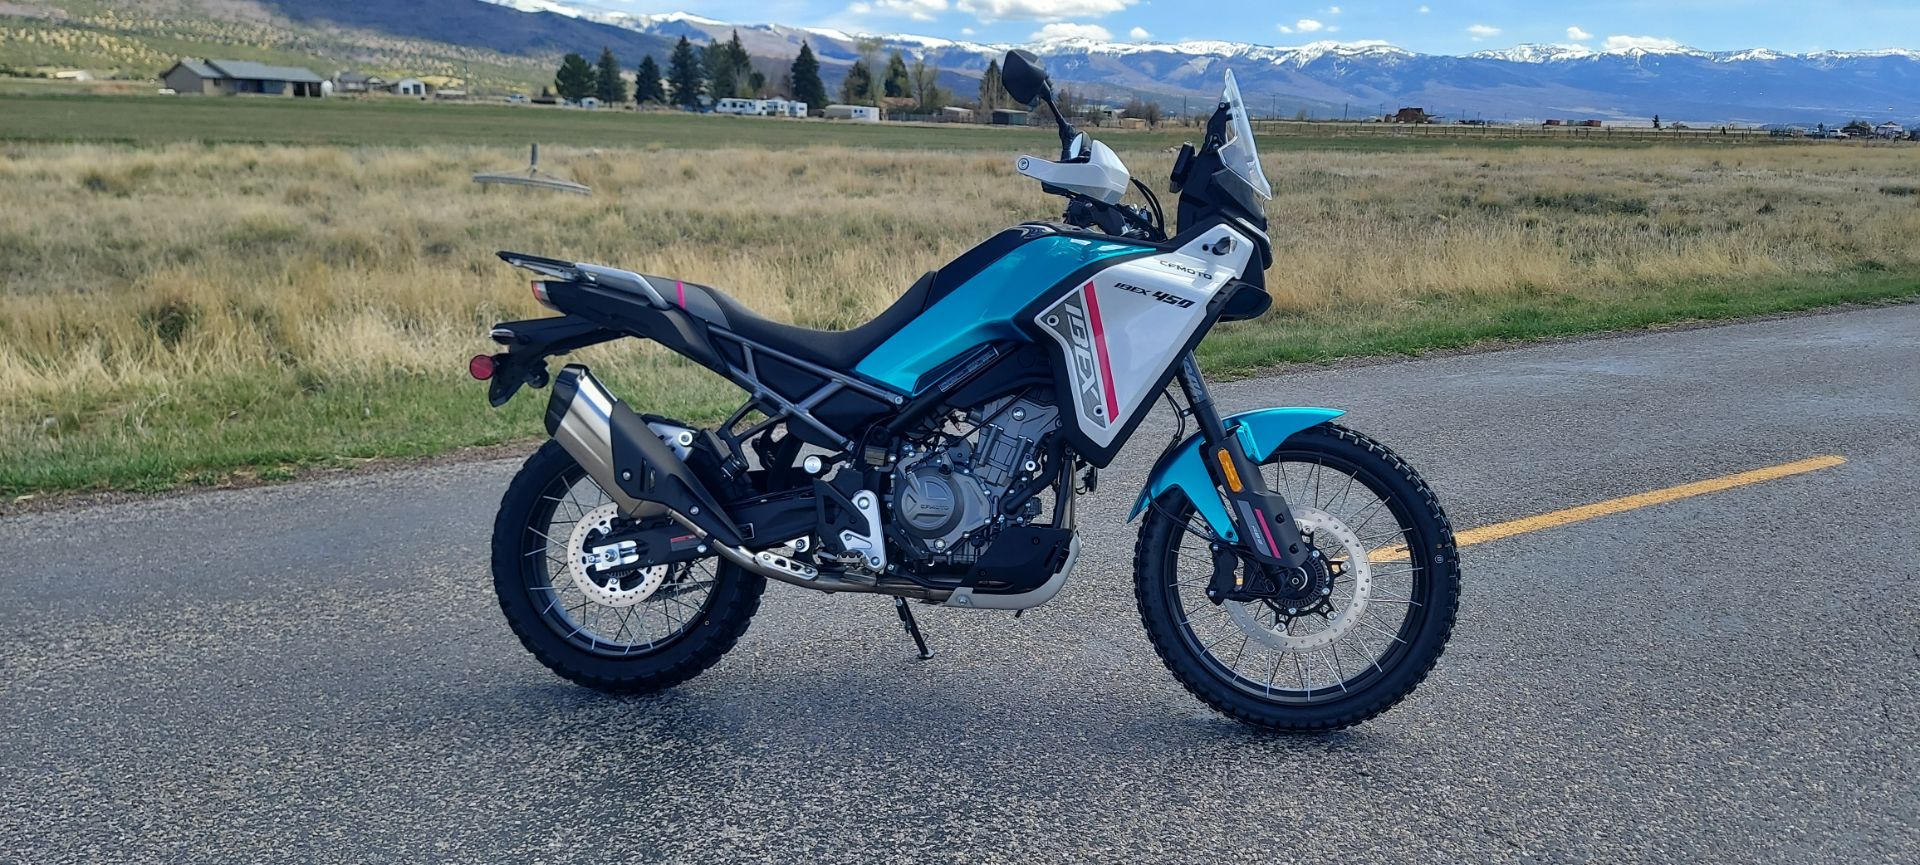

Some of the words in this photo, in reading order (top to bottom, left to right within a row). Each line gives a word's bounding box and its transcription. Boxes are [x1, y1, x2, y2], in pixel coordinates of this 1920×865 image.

[1160, 260, 1213, 280] CFMOTO
[1114, 282, 1151, 296] IBEX
[1152, 291, 1196, 308] 450
[1064, 303, 1099, 401] IBEX
